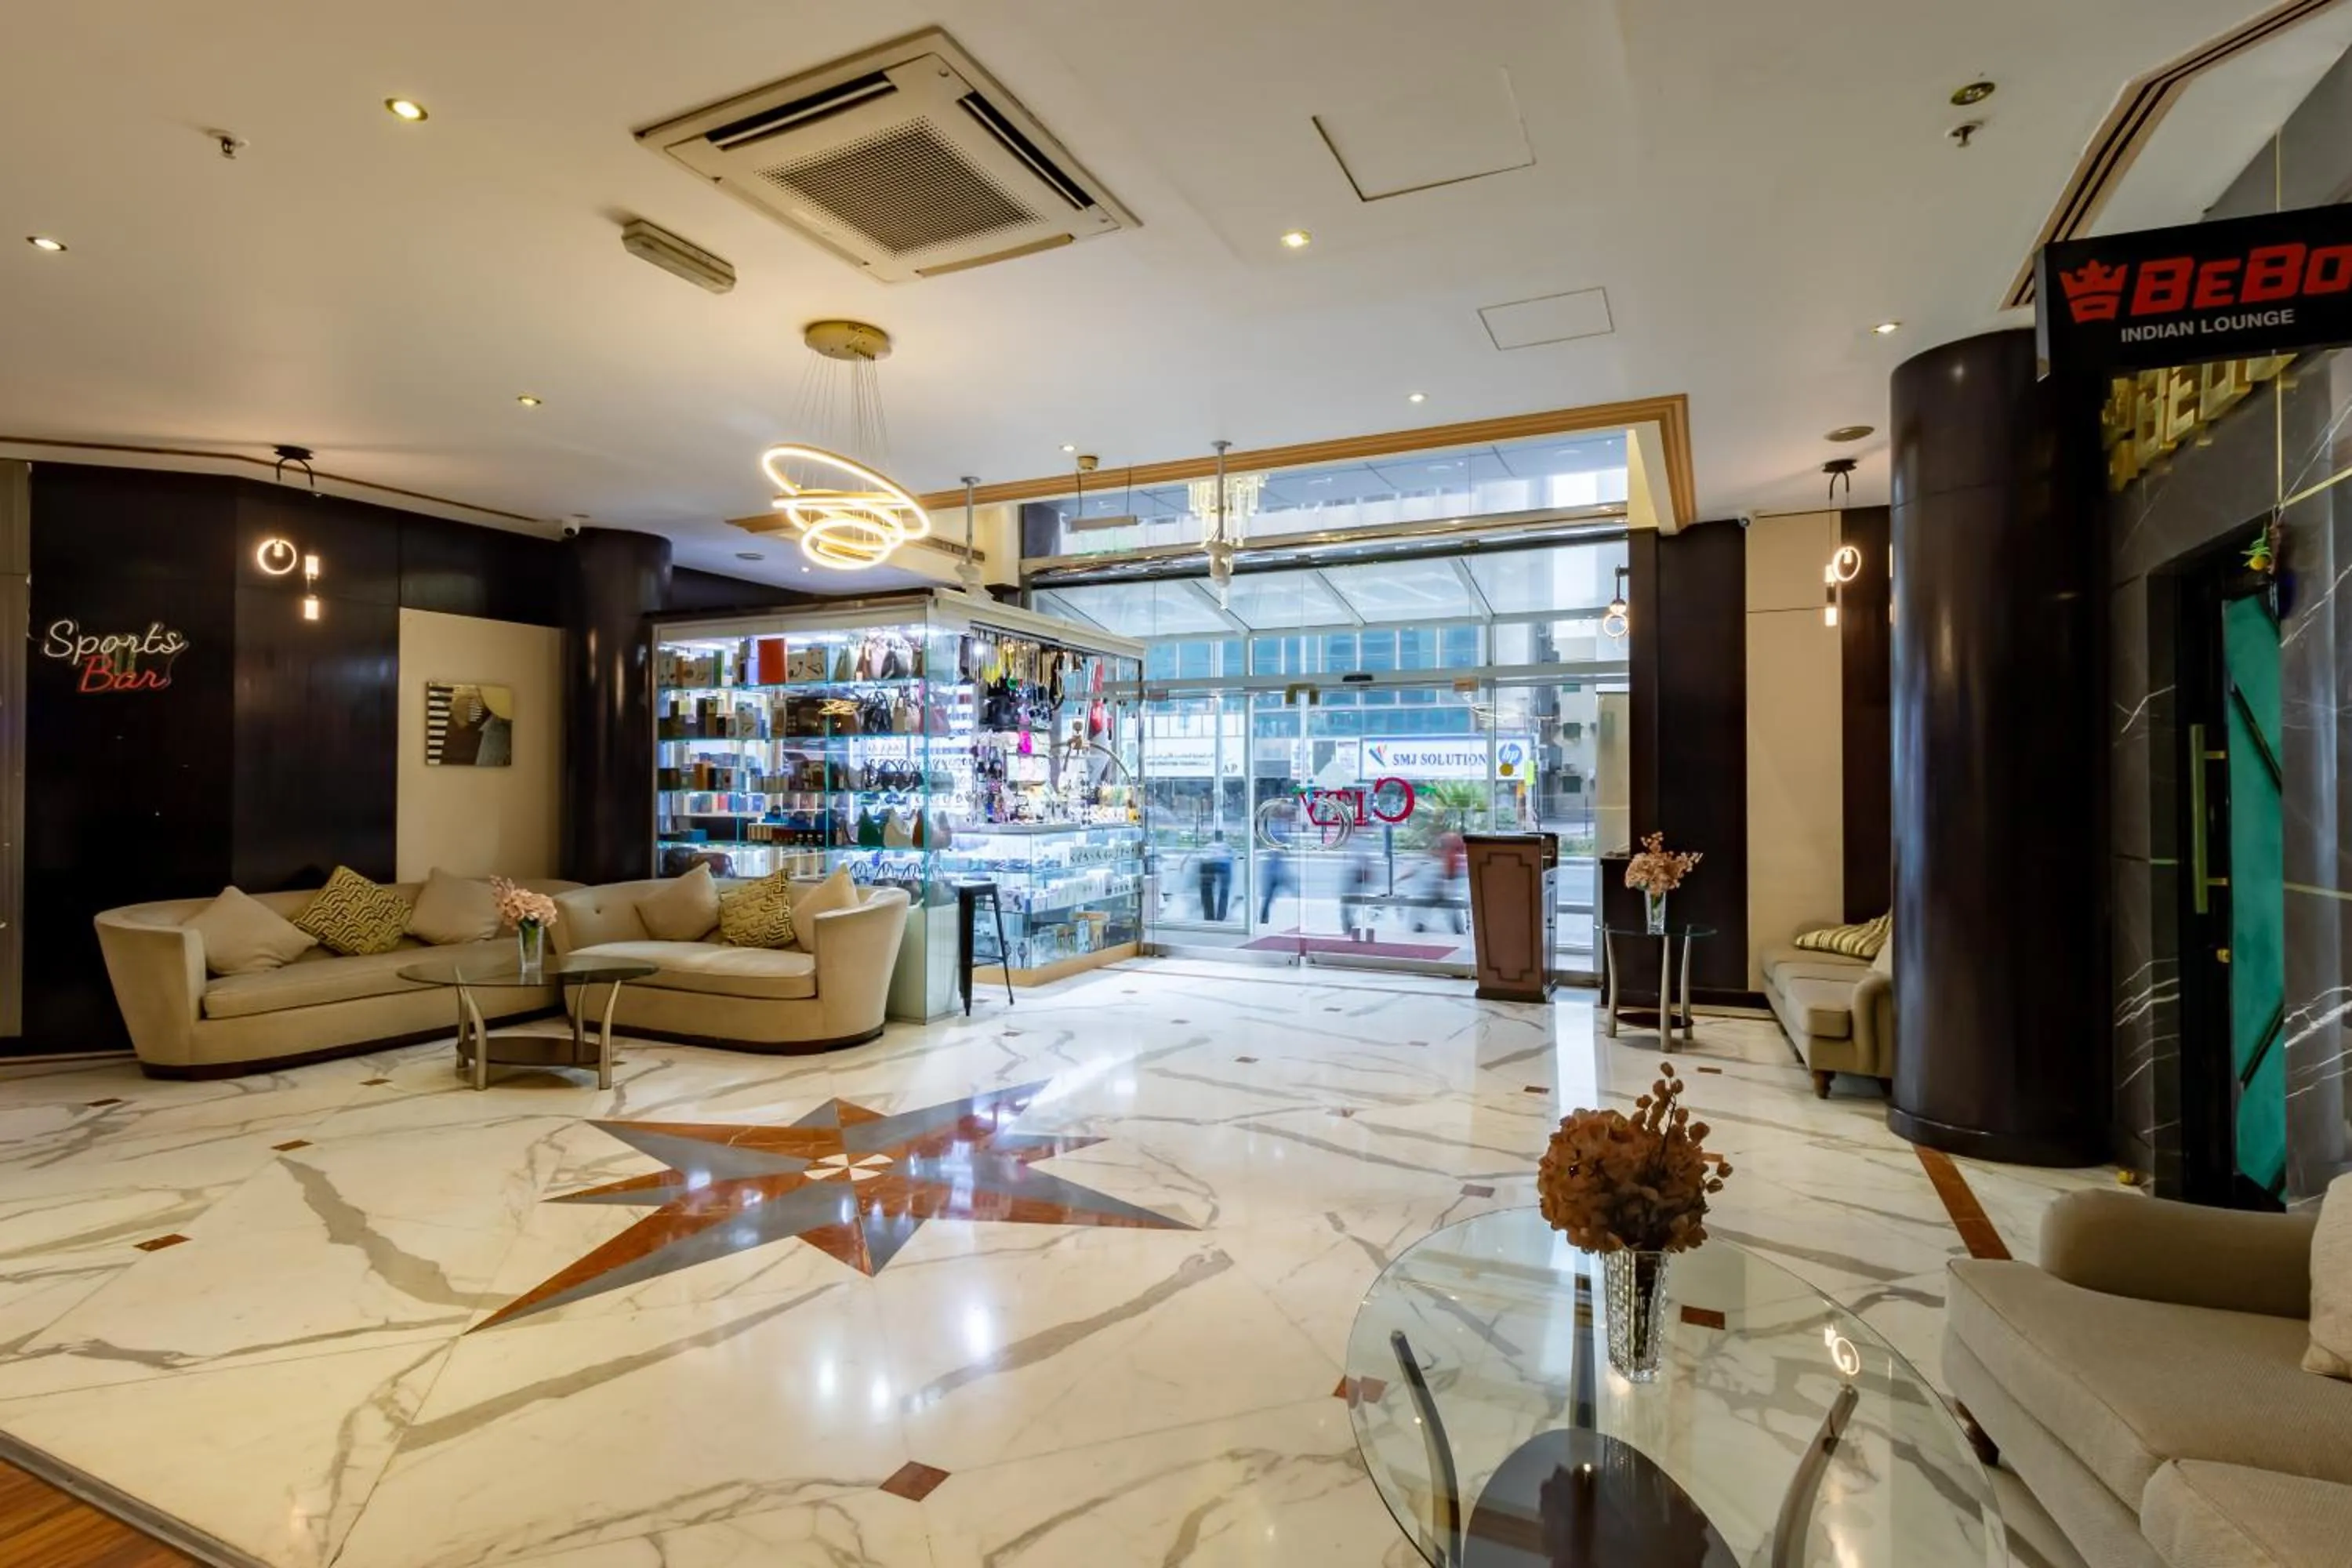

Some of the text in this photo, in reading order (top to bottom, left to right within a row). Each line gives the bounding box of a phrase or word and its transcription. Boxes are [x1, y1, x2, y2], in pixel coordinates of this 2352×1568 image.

[2120, 308, 2296, 343] INDIAN LOUNGE
[43, 619, 187, 666] Sports
[80, 654, 167, 692] Bar
[1392, 753, 1417, 767] SMJ
